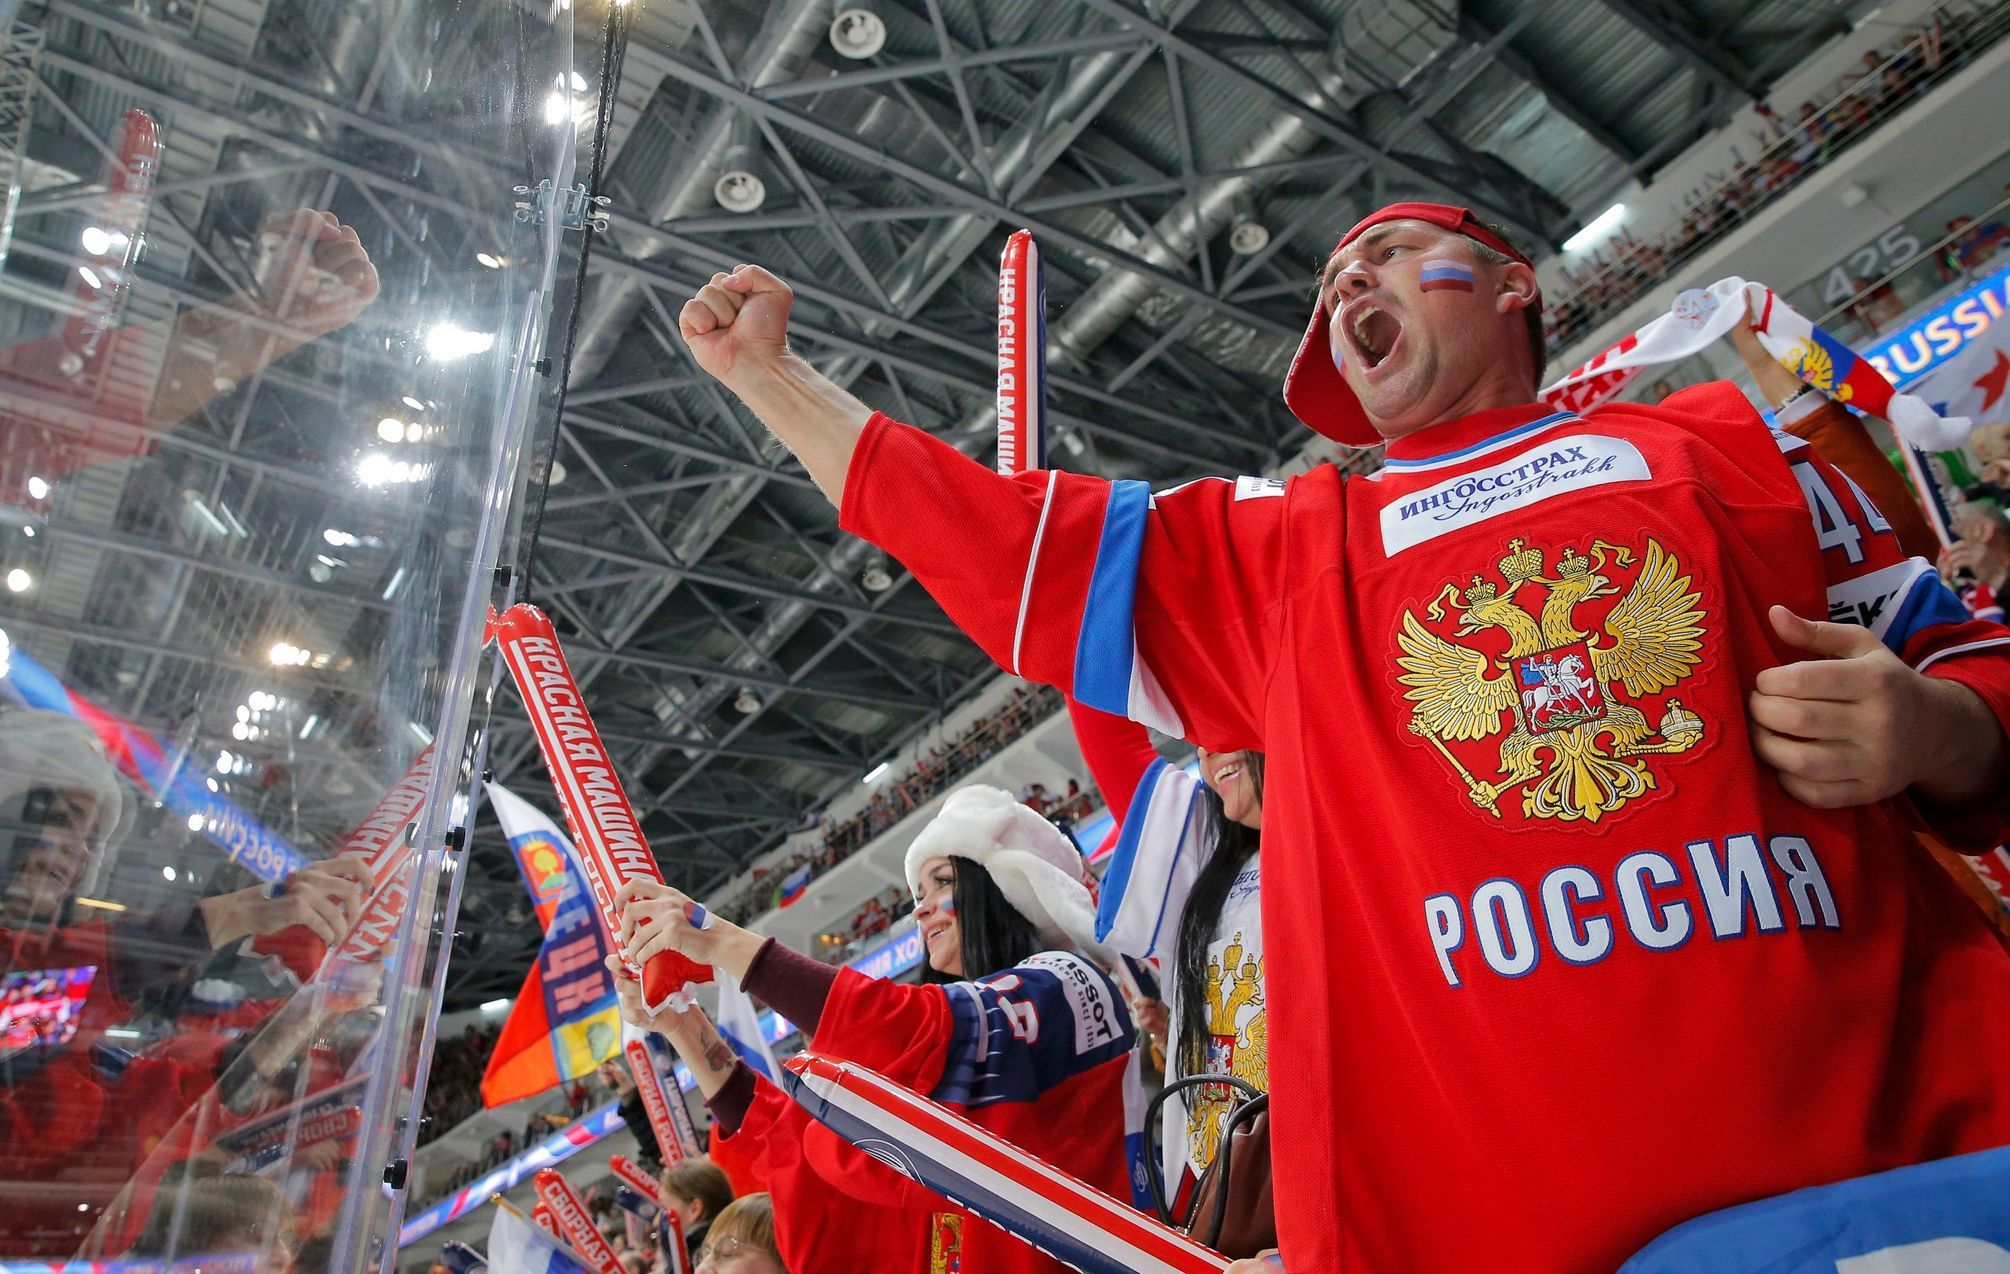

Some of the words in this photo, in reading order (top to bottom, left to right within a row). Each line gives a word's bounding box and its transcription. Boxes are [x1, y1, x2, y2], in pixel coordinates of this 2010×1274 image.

[1823, 223, 1921, 305] 425
[1868, 274, 2010, 385] RUSSI
[996, 396, 1016, 478] МАШИ
[1399, 446, 1589, 521] ИНГОССТРАХ
[1432, 454, 1617, 521] Ingosstrakh
[520, 636, 603, 762] КРАСНАЯ
[1422, 833, 1842, 988] РОССИЯ
[1055, 957, 1112, 1040] TISSOT
[543, 1181, 611, 1264] СБОРНАЯ
